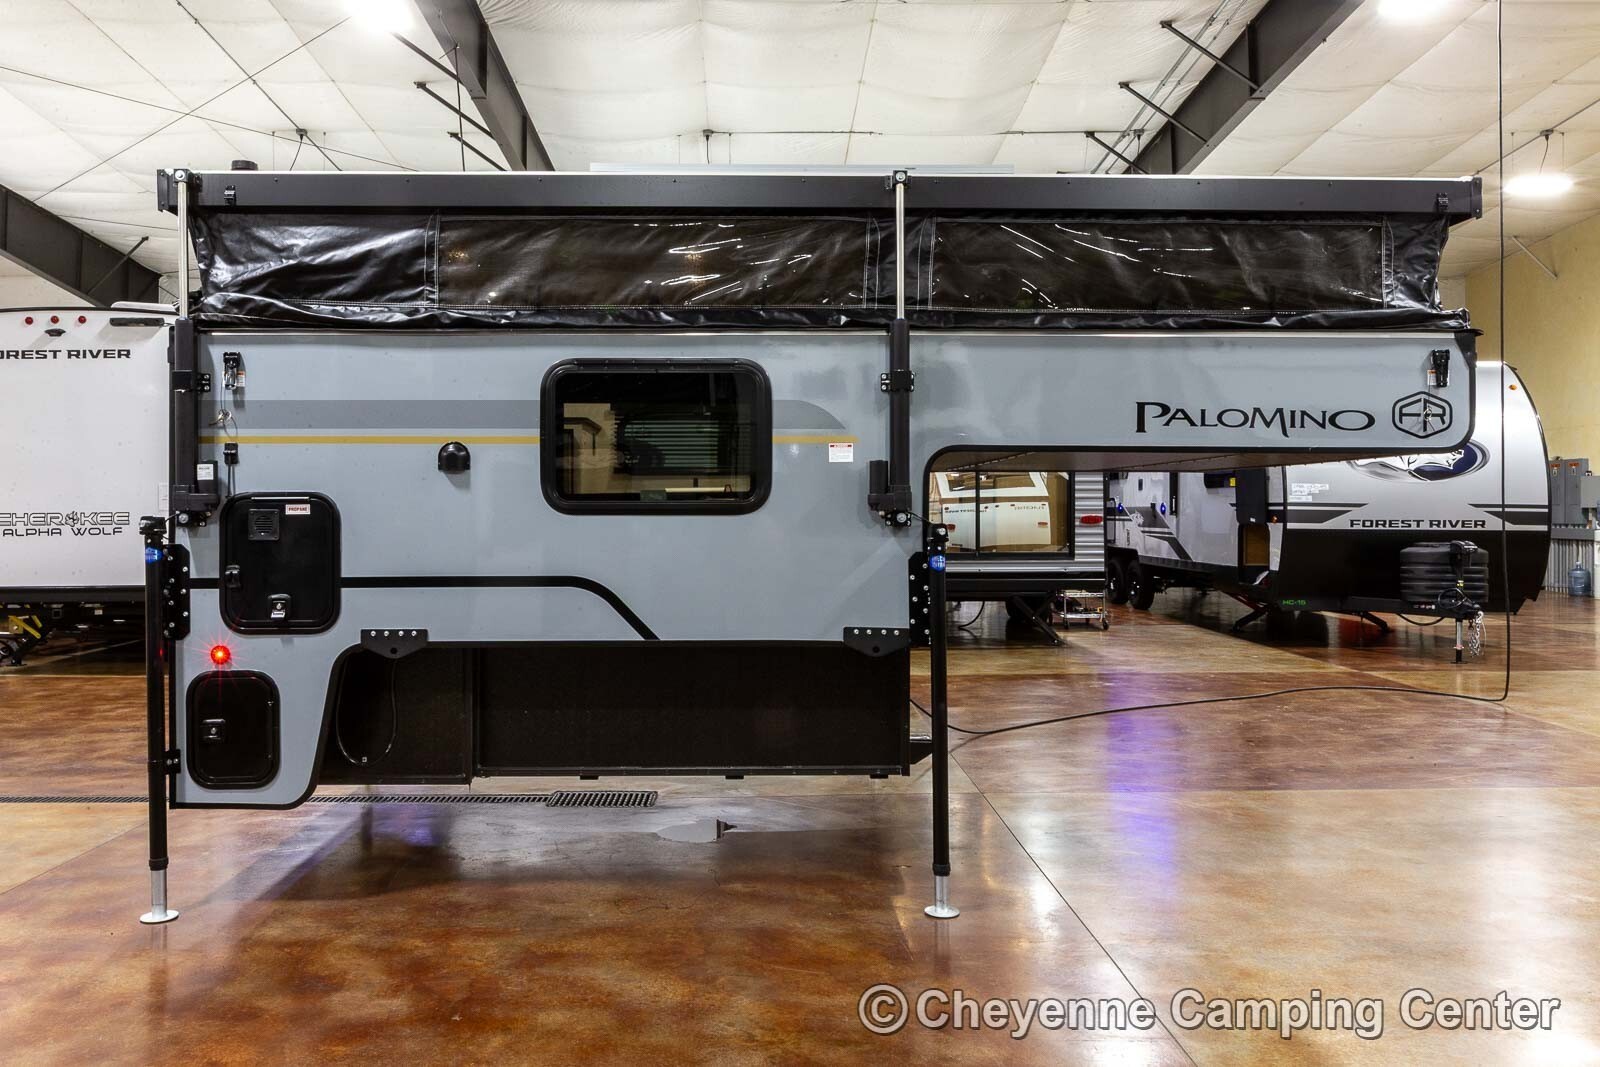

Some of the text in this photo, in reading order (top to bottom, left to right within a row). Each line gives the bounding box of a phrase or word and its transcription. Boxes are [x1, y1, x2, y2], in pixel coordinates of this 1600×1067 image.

[67, 349, 131, 359] RIVER
[1350, 519, 1486, 529] FOREST RIVER
[2, 527, 123, 537] ALPHA WOLF
